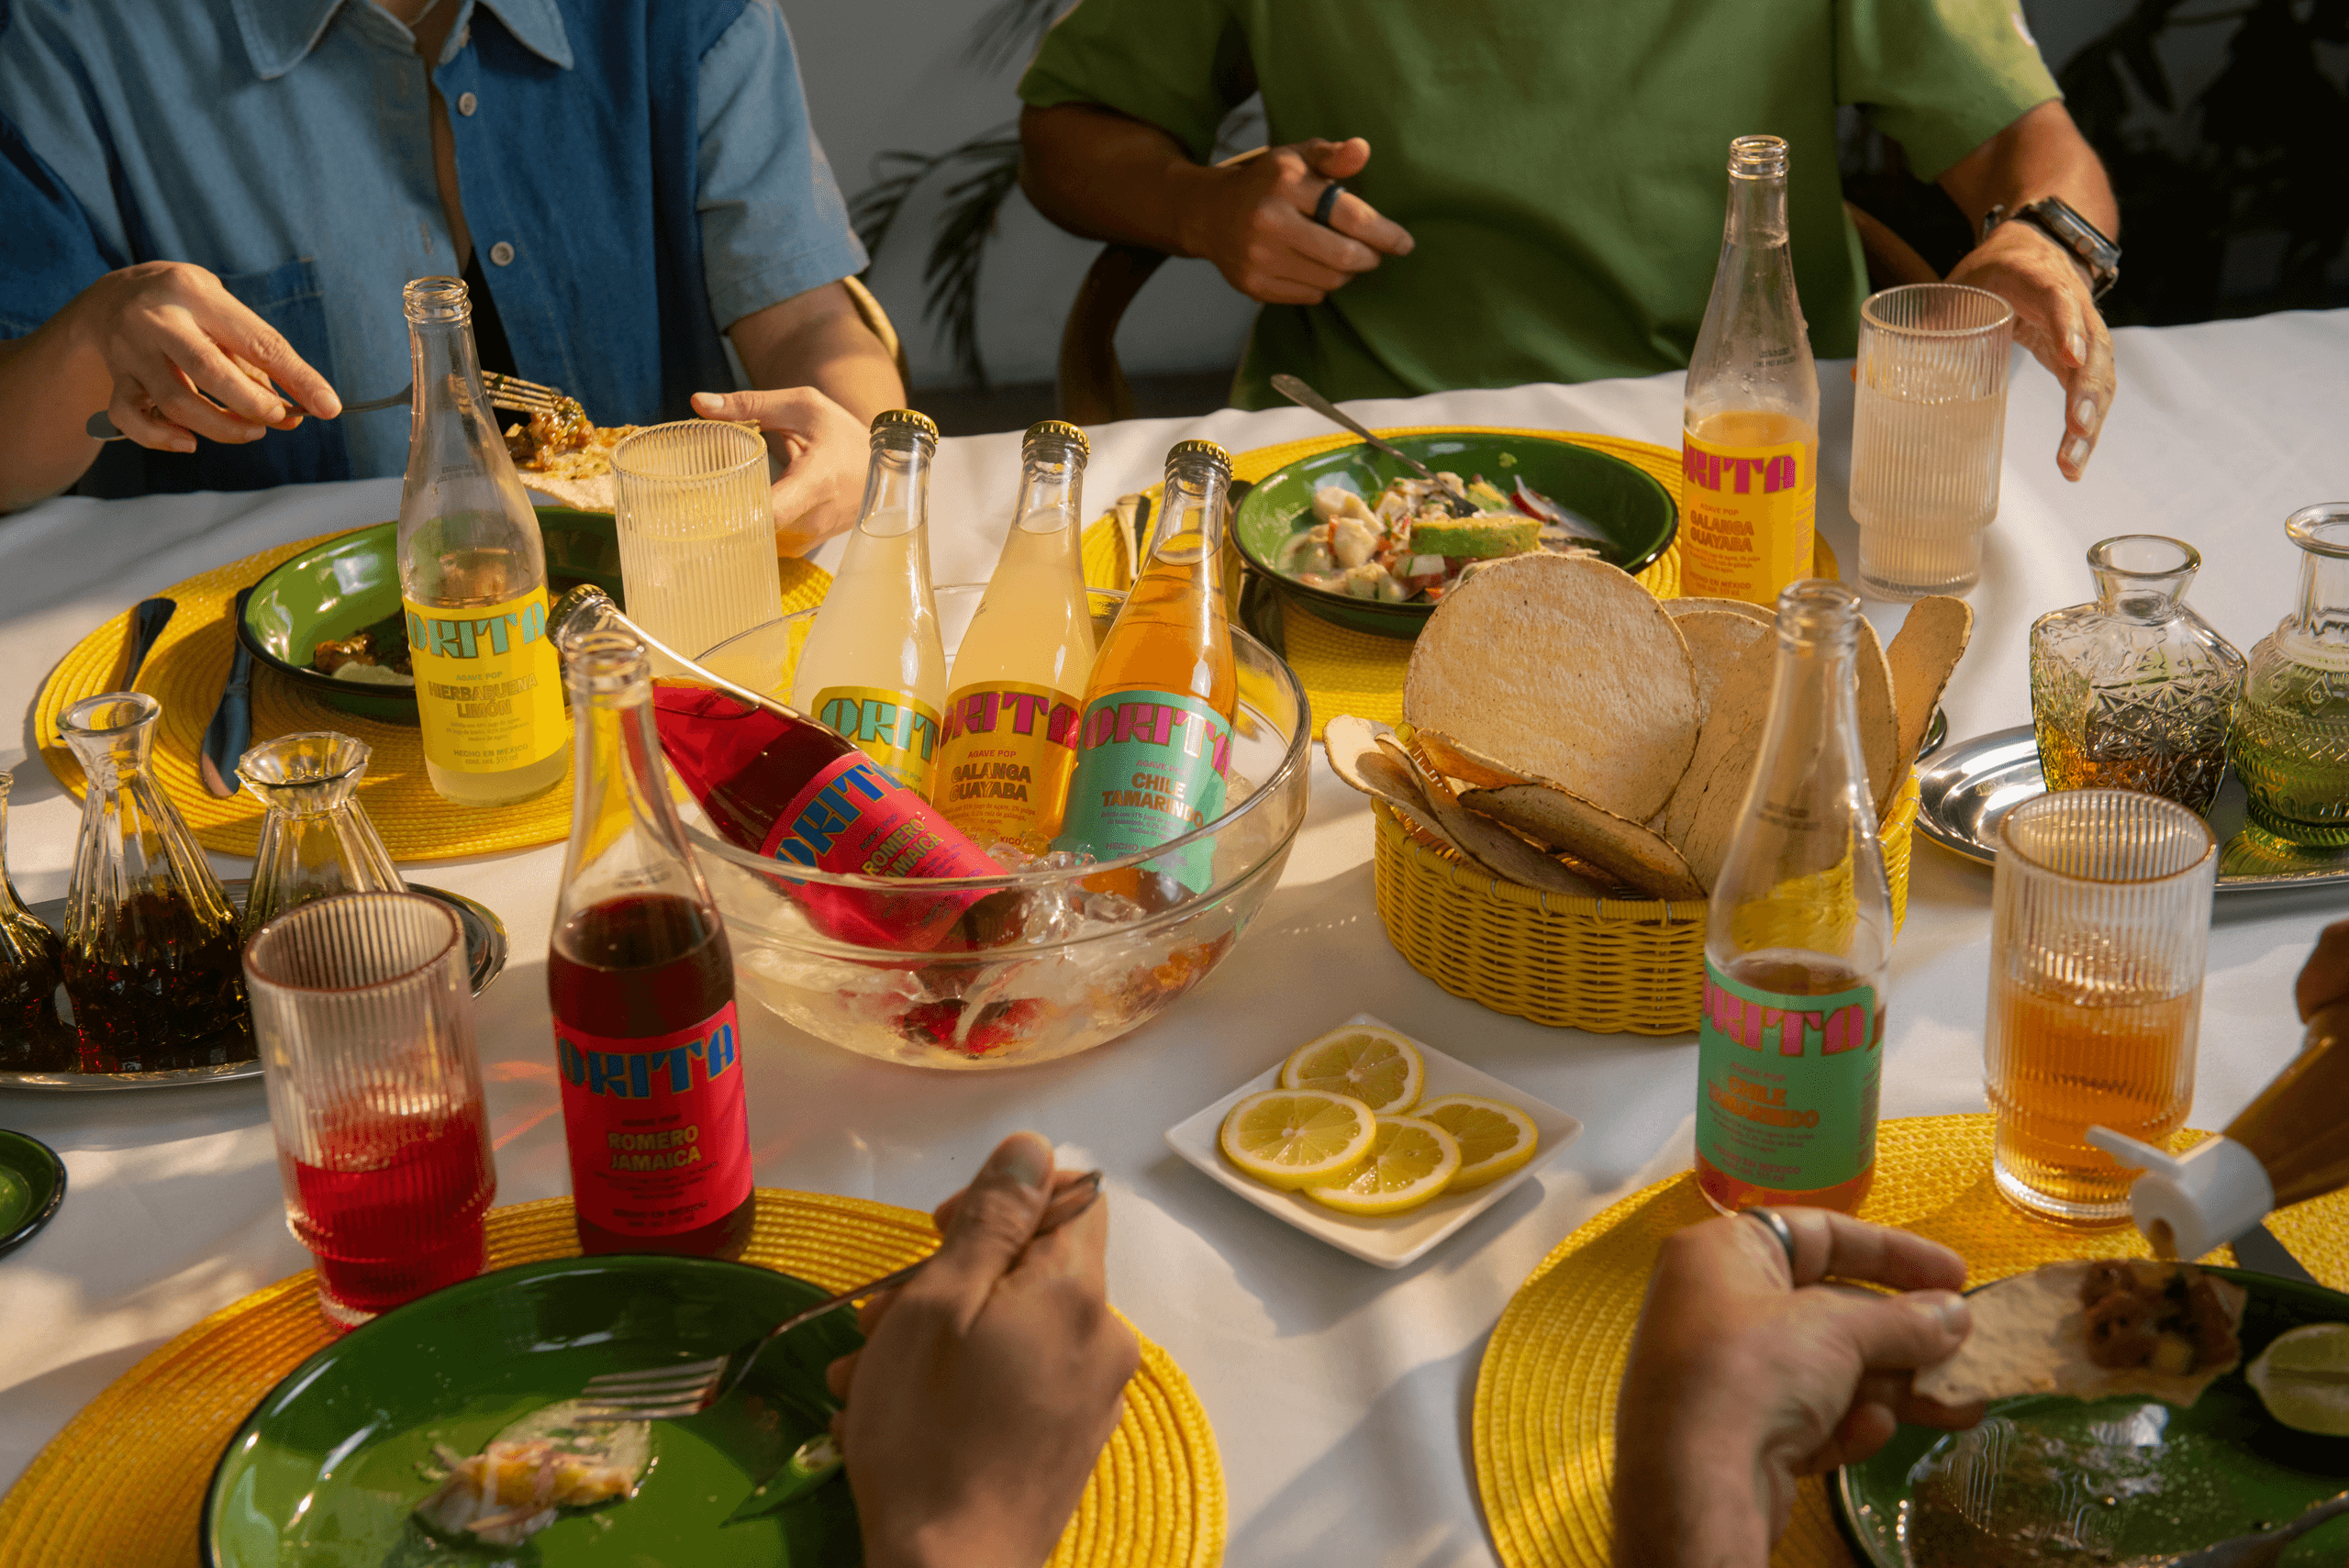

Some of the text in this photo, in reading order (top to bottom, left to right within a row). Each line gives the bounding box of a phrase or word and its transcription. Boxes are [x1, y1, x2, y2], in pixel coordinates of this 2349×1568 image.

[1690, 509, 1755, 537] GALANGA
[1690, 527, 1753, 553] GUAYABA
[428, 673, 539, 702] HIERBABUENA
[456, 671, 503, 682] AGAVE POP
[457, 698, 512, 718] LIMÓN
[820, 697, 941, 762] ORIT
[453, 749, 481, 757] HECHO
[968, 749, 1017, 759] AGAVE POP
[1136, 760, 1167, 771] AGAVE
[952, 762, 1032, 784] GALANGA
[1131, 772, 1186, 800] CHILE
[950, 782, 1029, 803] GUAYABA
[1101, 790, 1204, 828] TAMARINDO
[861, 817, 927, 877] ROMERO
[884, 830, 945, 878] MAICA
[999, 836, 1022, 846] XICO
[1106, 842, 1139, 852] HECHO
[559, 1021, 736, 1099] ORITA
[607, 1124, 699, 1152] ROMERO
[610, 1144, 703, 1173] JAMAICA
